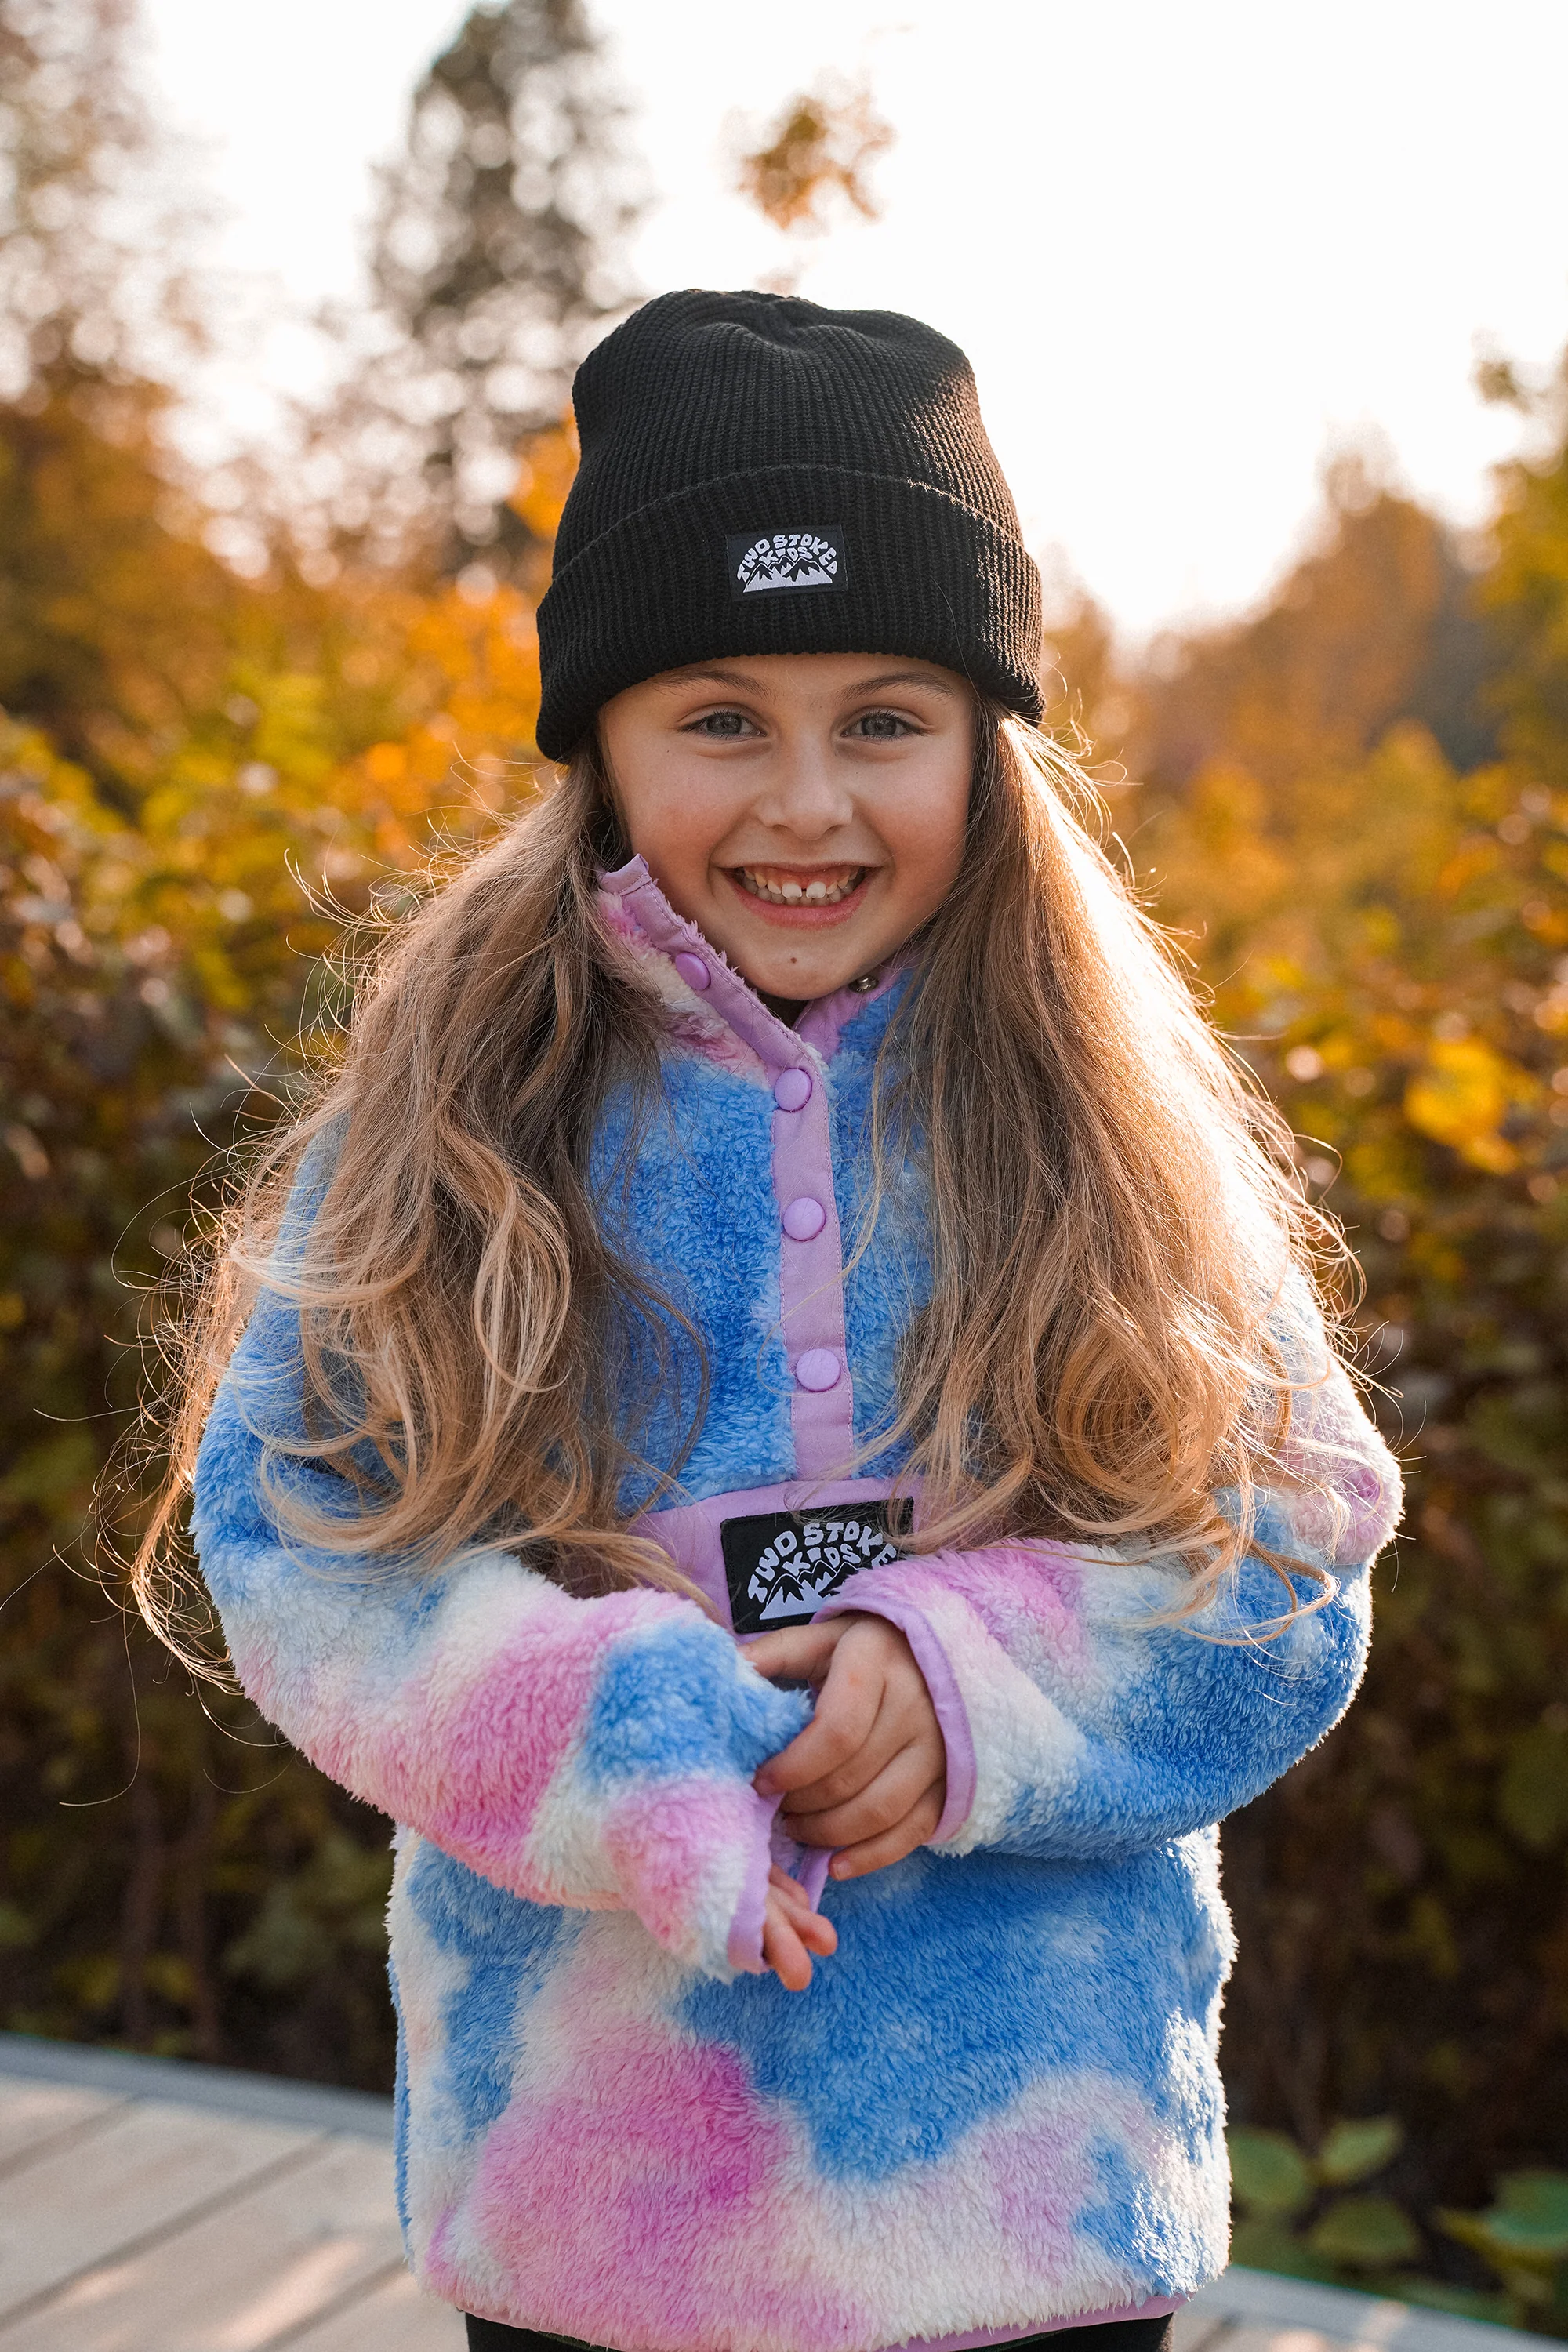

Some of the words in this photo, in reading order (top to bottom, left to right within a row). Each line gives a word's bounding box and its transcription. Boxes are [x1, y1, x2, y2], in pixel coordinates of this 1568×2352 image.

[737, 539, 771, 583] TWO
[773, 534, 838, 575] STOKED
[759, 546, 813, 564] KIDS
[747, 1530, 797, 1603] TWO
[803, 1521, 897, 1568] STOKE
[782, 1543, 861, 1577] KIDS
